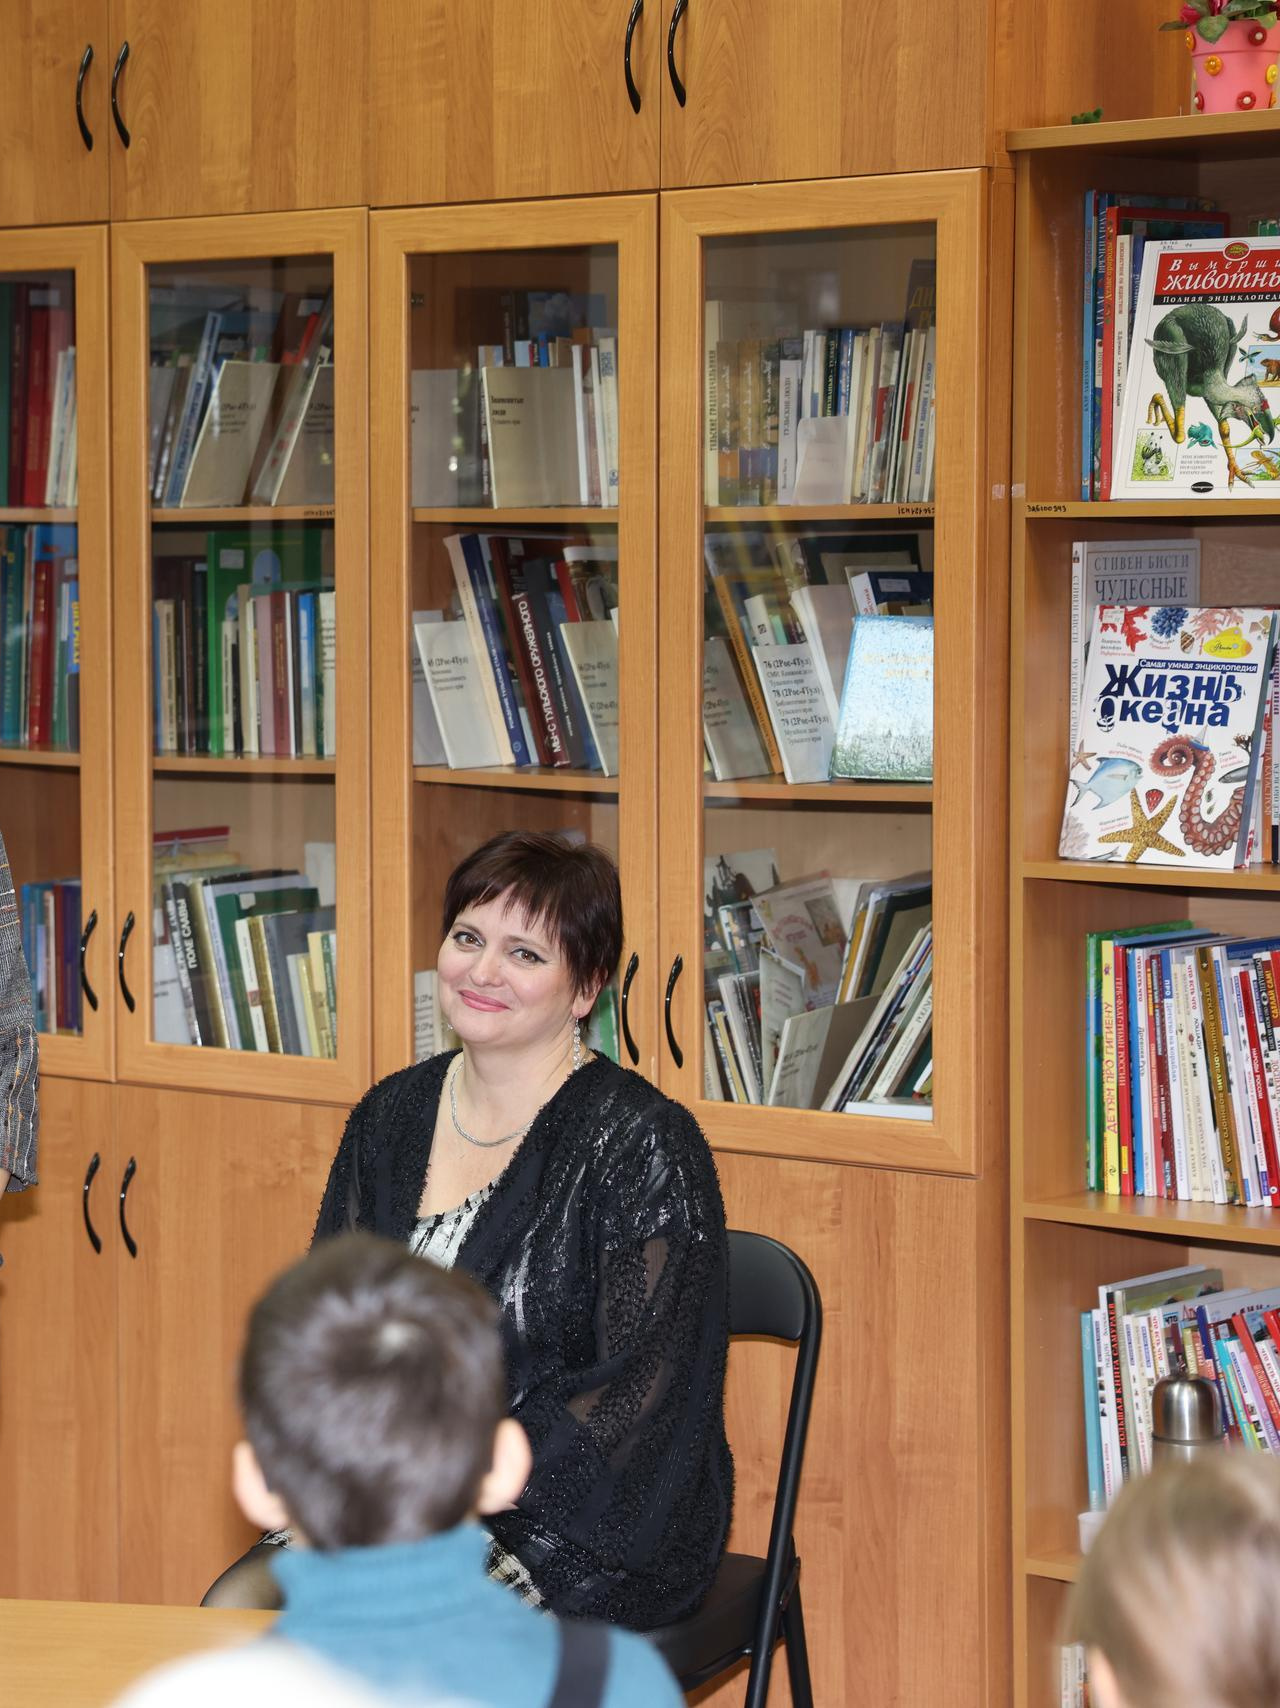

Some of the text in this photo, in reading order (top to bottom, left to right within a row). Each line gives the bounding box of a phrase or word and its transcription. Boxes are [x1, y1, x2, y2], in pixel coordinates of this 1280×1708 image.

[1094, 554, 1189, 571] СТИВЕН БИСТИ
[1095, 576, 1188, 602] ЧУДЕСНЫЕ
[514, 598, 545, 668] ОРУЖЕЙНОГО
[1100, 664, 1246, 704] Жизнь
[1140, 659, 1257, 673] Самая умная энциклопедия
[532, 666, 556, 722] ТУЛЬСКОГО
[176, 897, 192, 938] СЛАВЫ
[183, 937, 198, 969] ПОЛЕ
[1163, 978, 1171, 996] ПРО
[1203, 981, 1214, 1020] ДЕТСКАЯ
[1263, 969, 1279, 1019] СДЕЛАЙ САМ!
[1103, 1001, 1118, 1133] ДЕТЯМ ПРО ГИГИЕНУ
[1250, 1047, 1263, 1099] НАРОДЫ РОССИИ
[1106, 1302, 1127, 1447] БОЛЬШАЯ КНИГА САМУРАЕВ
